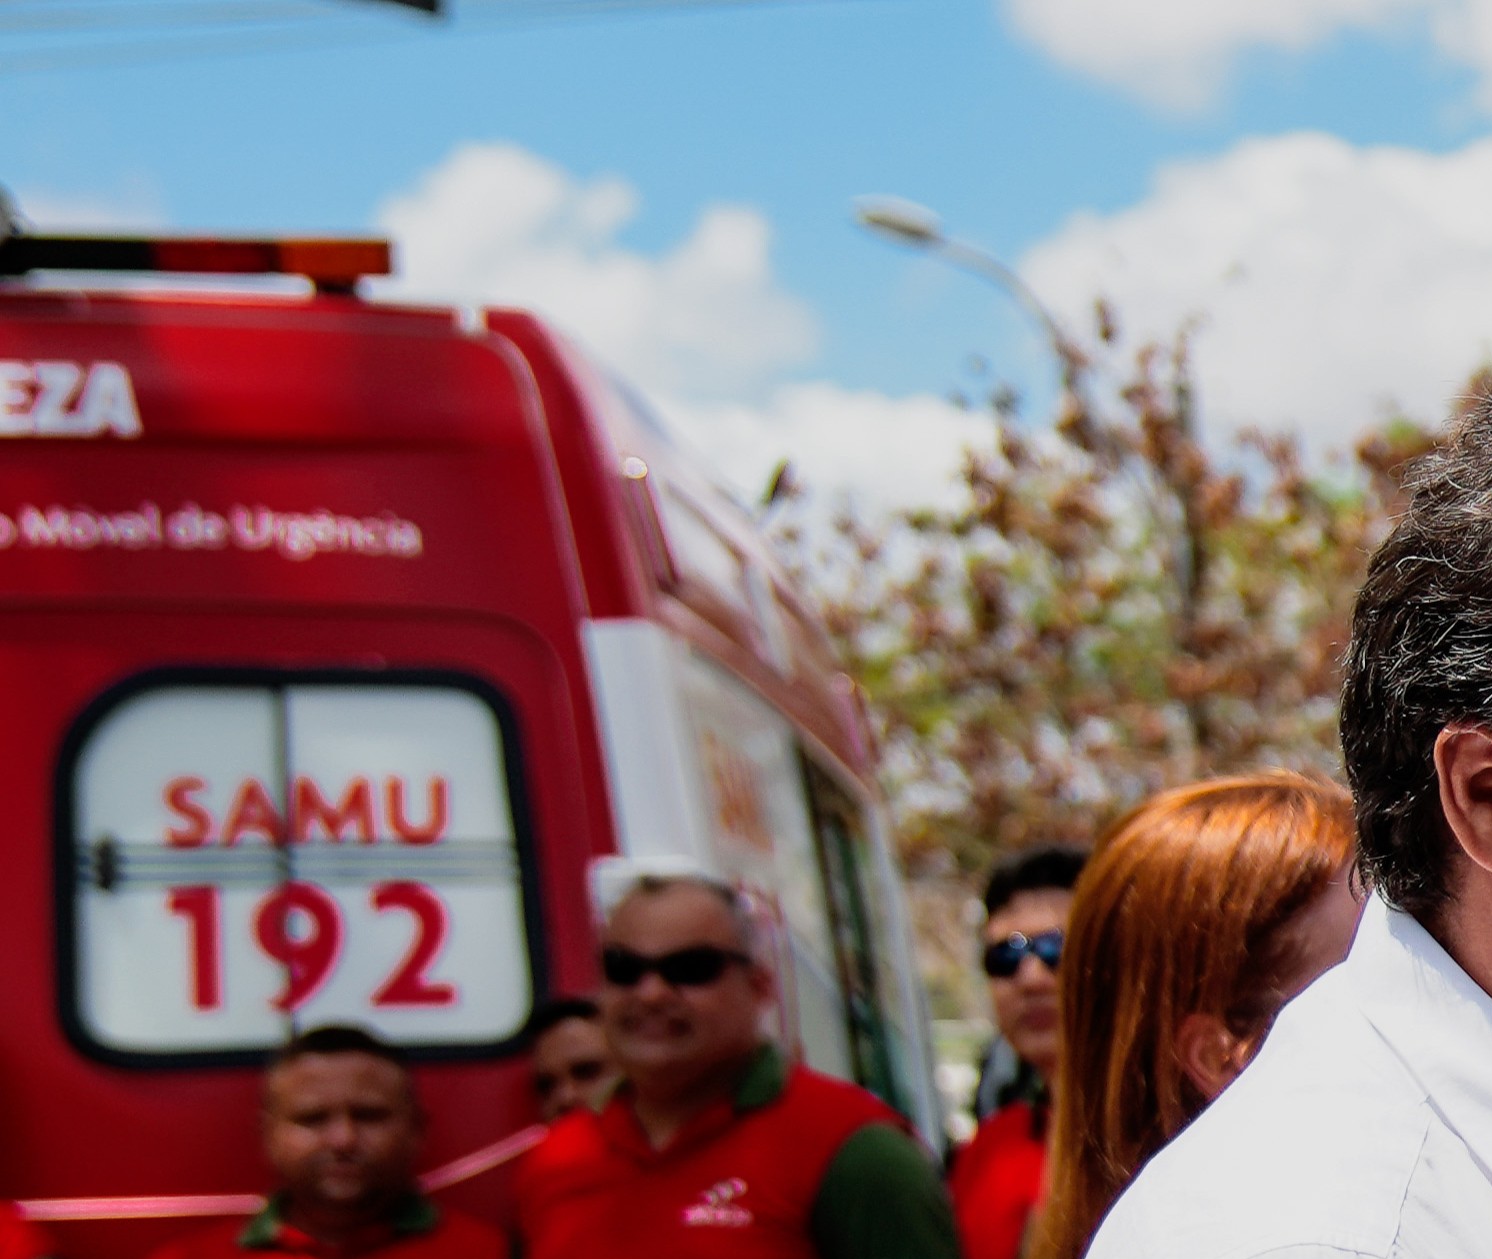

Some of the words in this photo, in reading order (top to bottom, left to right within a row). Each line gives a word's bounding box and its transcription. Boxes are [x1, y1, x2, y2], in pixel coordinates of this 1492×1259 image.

[166, 502, 230, 550] de
[161, 774, 451, 850] SAMU
[164, 879, 459, 1013] 192
